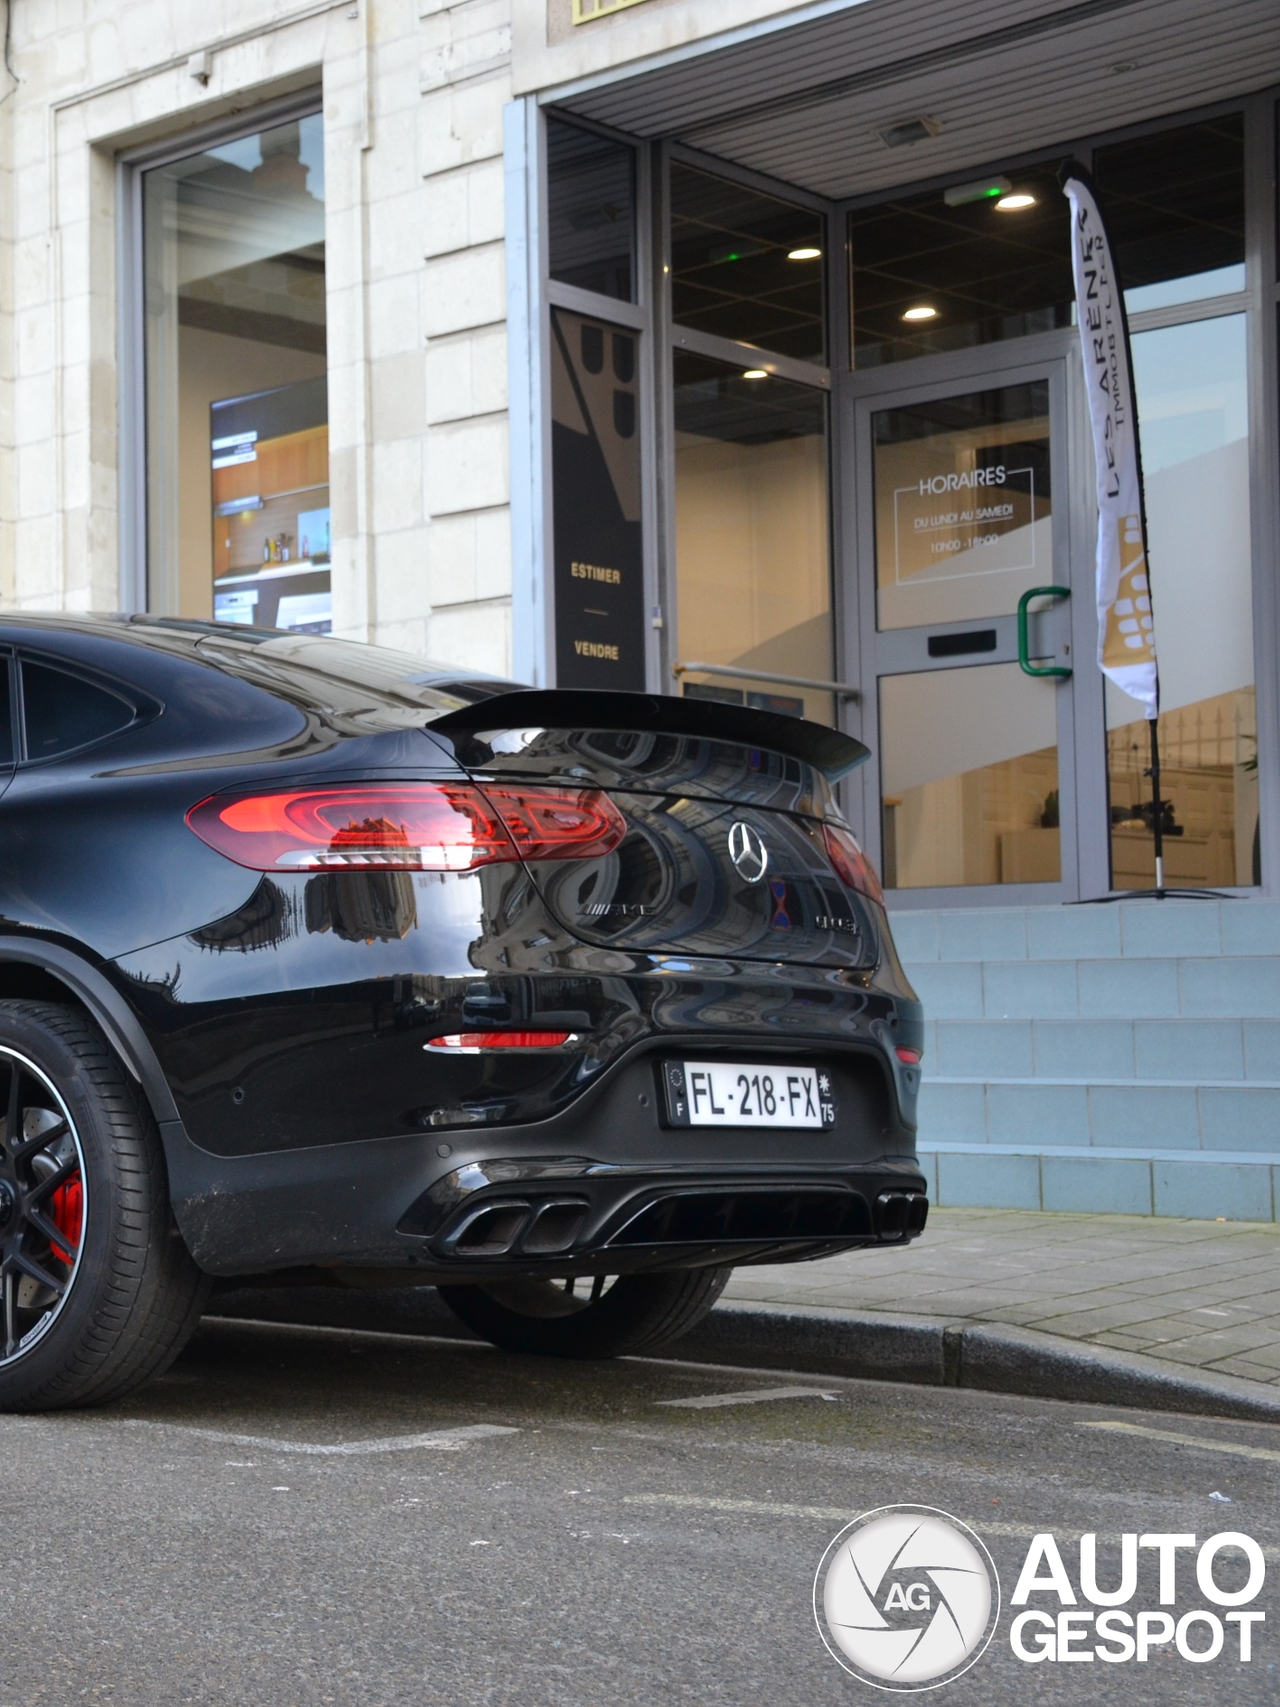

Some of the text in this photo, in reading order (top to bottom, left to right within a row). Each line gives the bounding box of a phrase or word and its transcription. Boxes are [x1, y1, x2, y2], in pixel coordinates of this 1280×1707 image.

[1104, 413, 1120, 498] LES
[919, 465, 1006, 496] HORAIRES
[914, 504, 1013, 529] DU LUNDI AU SAMEDI
[571, 562, 621, 584] ESTIMER
[574, 640, 619, 660] VENDRE
[676, 1103, 683, 1116] F
[821, 1104, 835, 1122] 75
